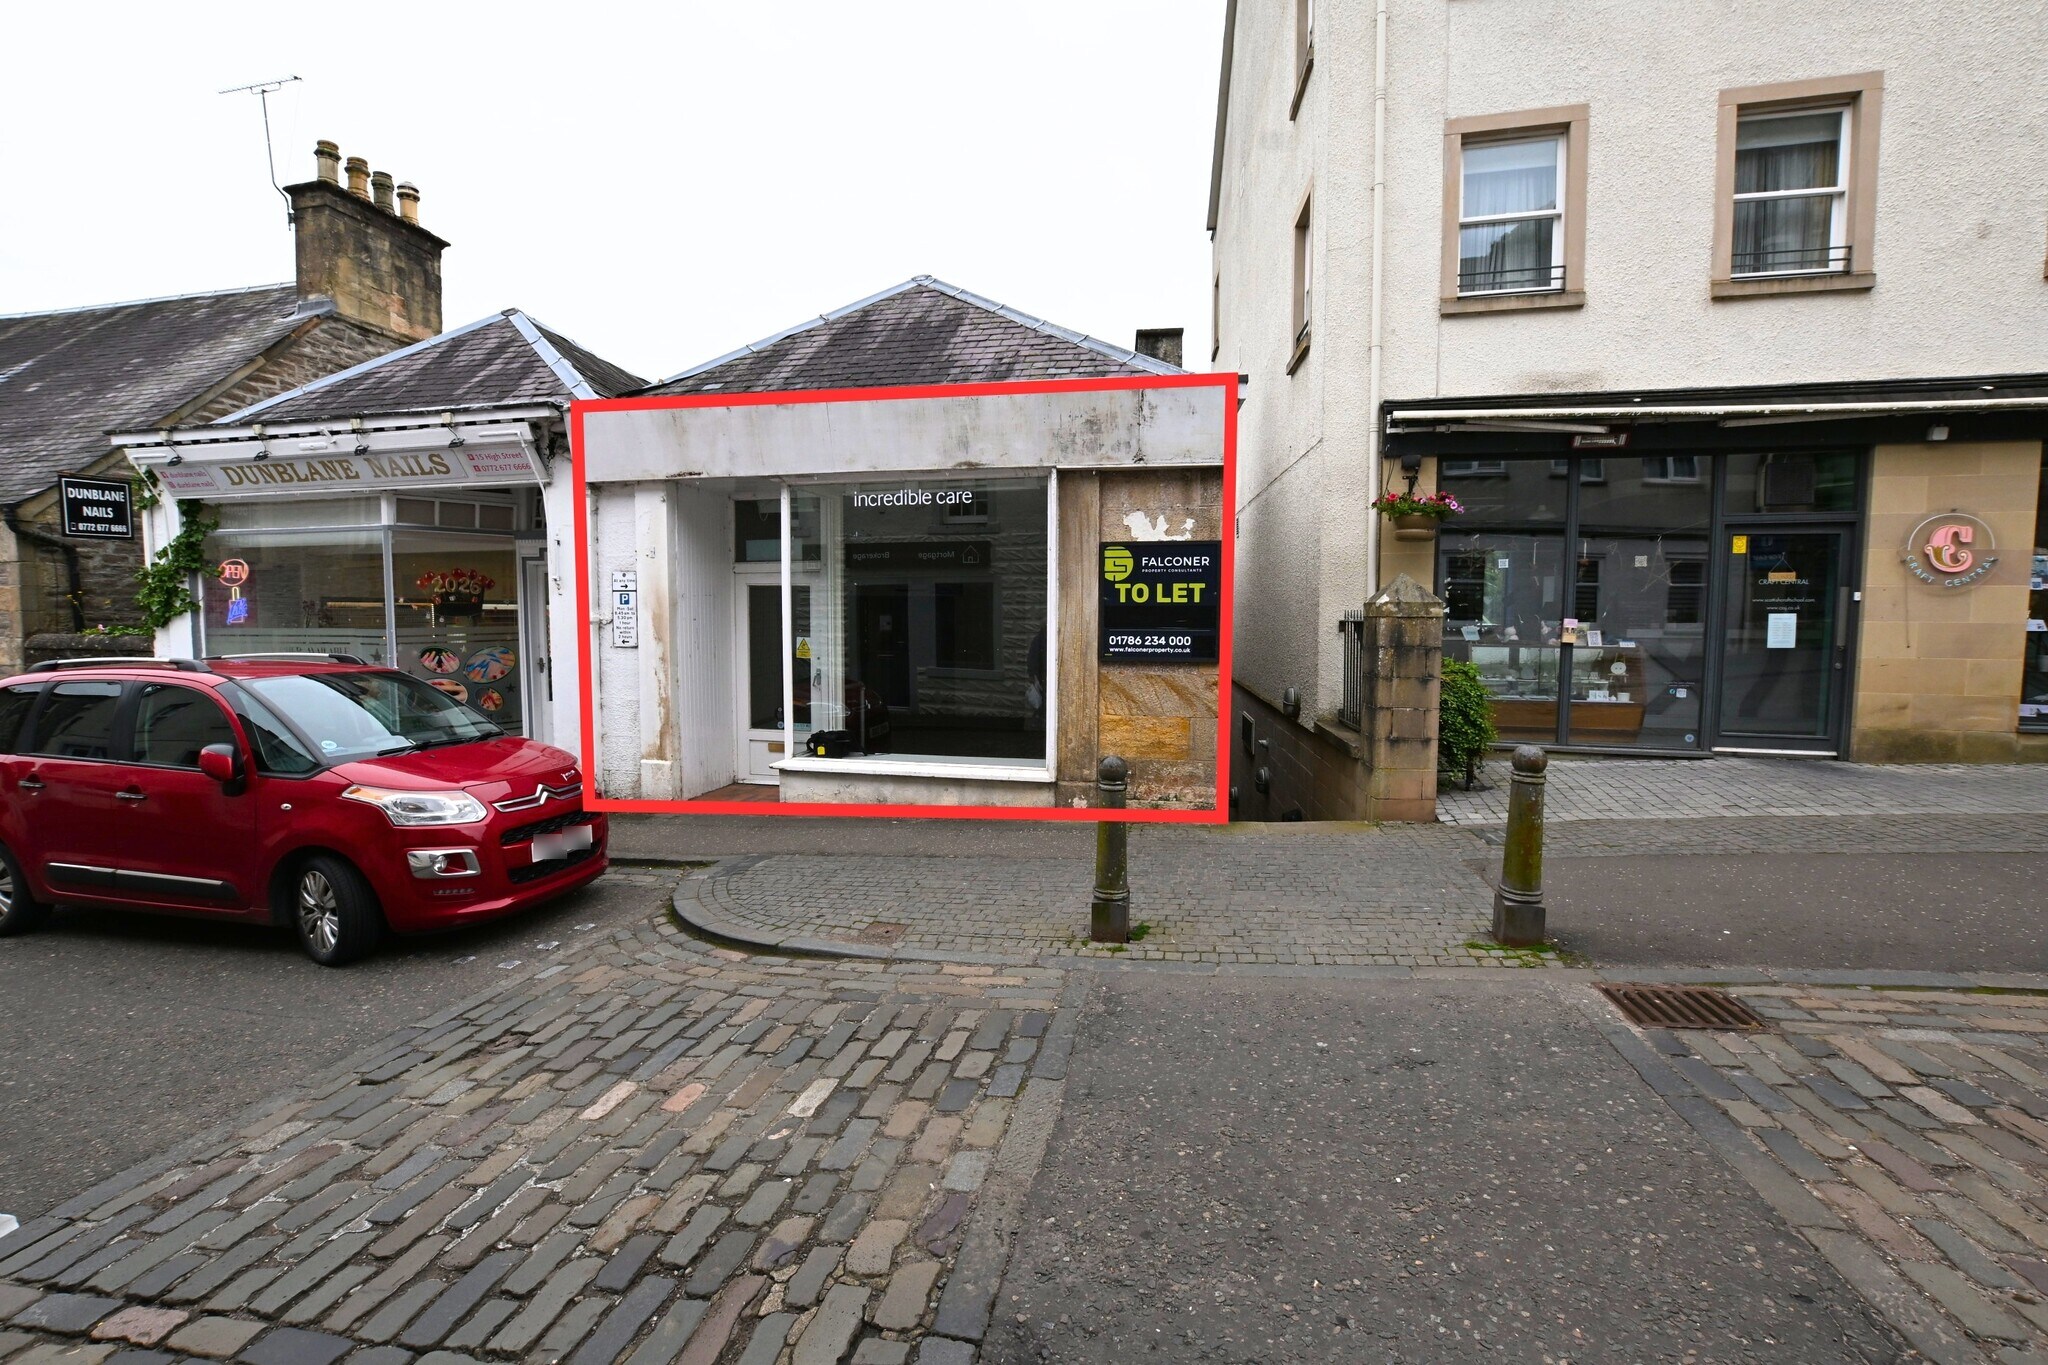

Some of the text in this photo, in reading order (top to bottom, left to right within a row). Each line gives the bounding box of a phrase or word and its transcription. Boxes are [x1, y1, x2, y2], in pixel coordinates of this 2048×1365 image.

[485, 453, 501, 461] High
[220, 453, 450, 486] DUNBLANE NAILS
[67, 487, 125, 502] DUNBLANE
[854, 489, 973, 507] incredible care
[82, 506, 114, 518] NAILS
[78, 522, 96, 531] 0772
[97, 524, 109, 532] 677
[1142, 556, 1210, 567] FALCONER
[1907, 555, 1994, 587] CRAFT CENTRAL
[431, 577, 482, 595] 2026
[1114, 583, 1206, 603] TO LET
[1109, 636, 1191, 645] 01786 234 000
